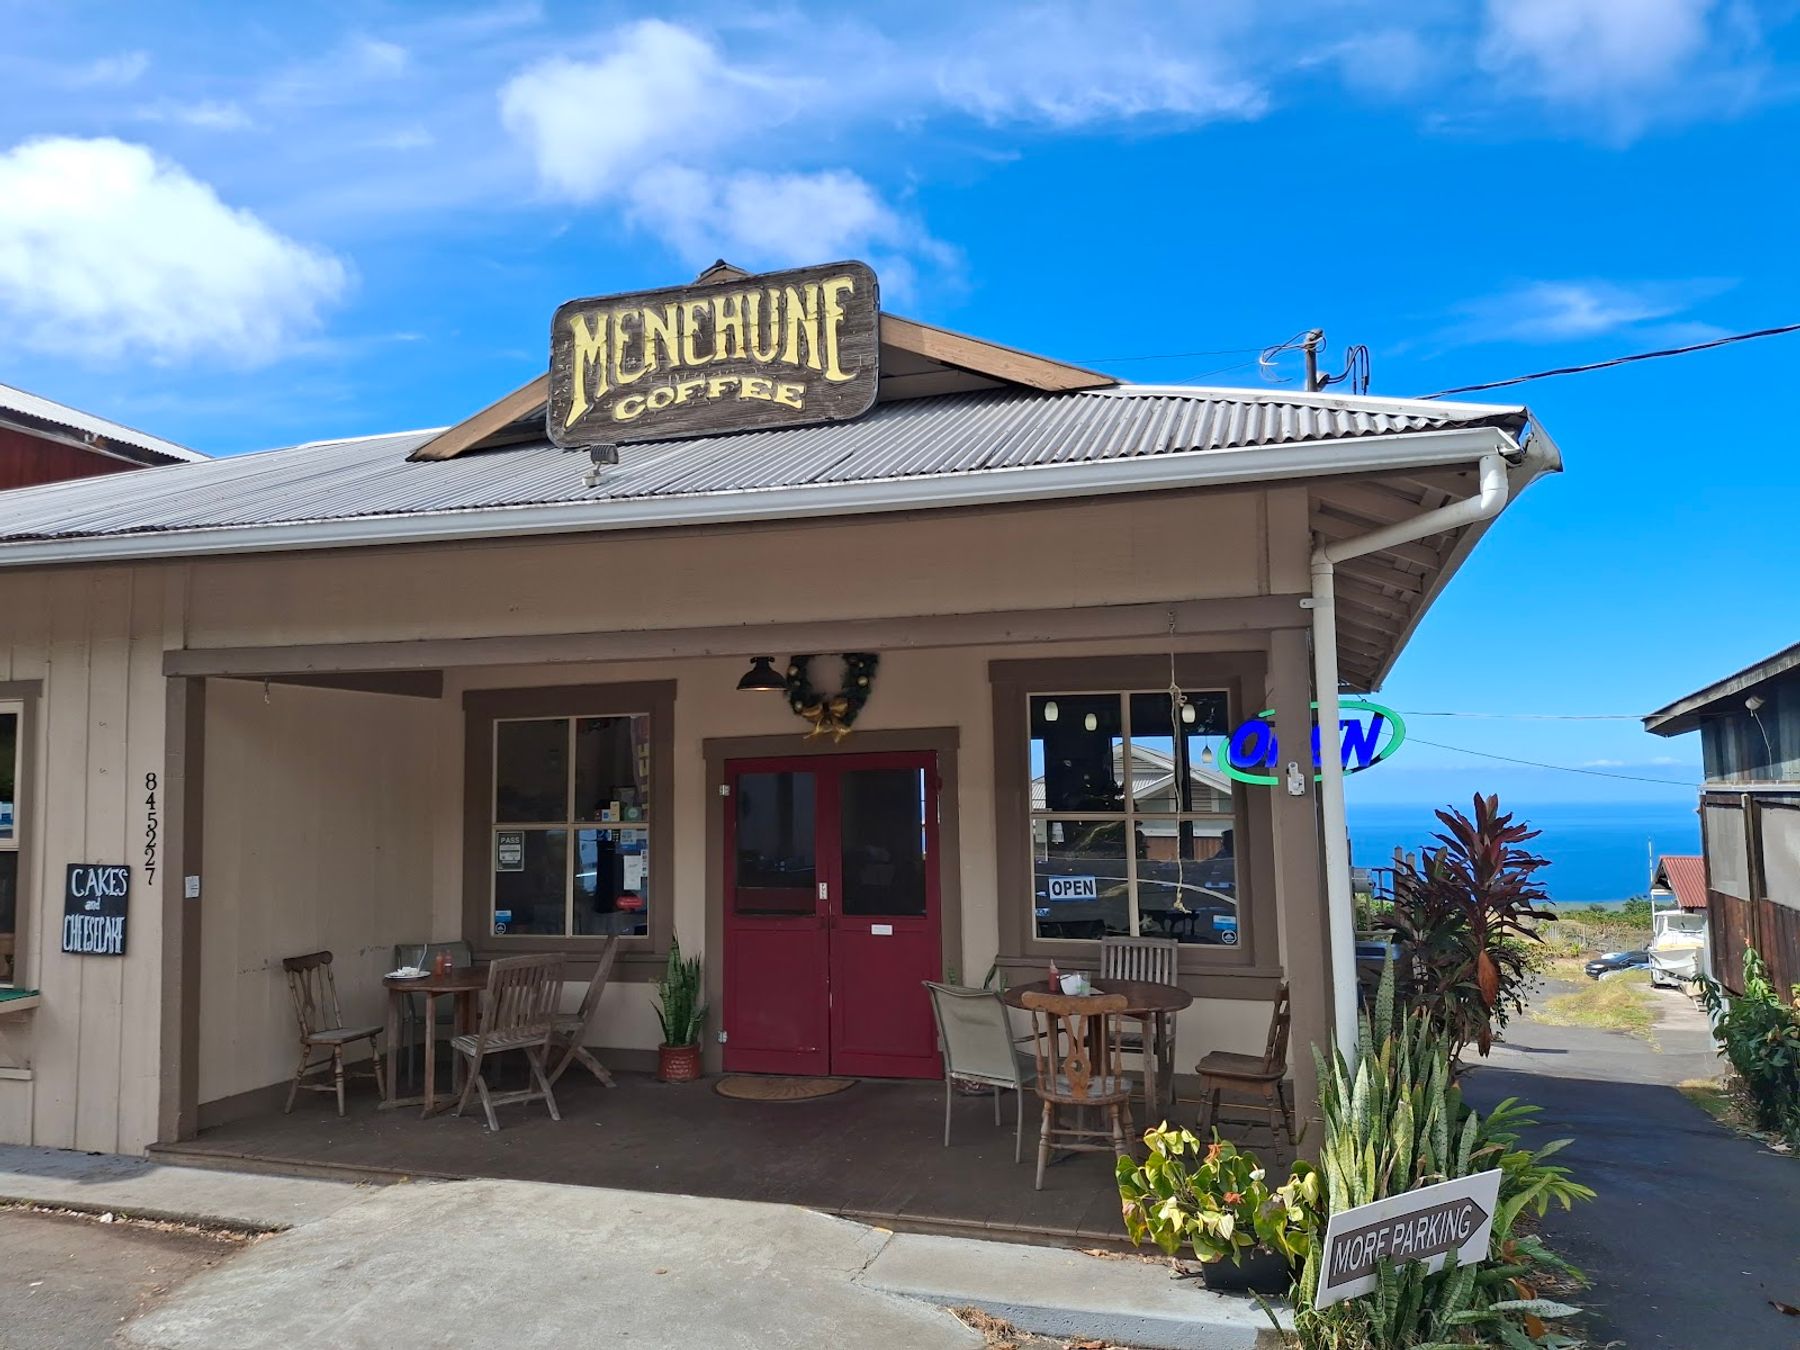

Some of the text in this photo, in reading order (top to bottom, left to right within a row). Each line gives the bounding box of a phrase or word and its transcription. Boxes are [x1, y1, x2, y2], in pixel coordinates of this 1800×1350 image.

[565, 276, 857, 428] MENEHUNE
[613, 376, 805, 420] COFFEE
[1230, 712, 1385, 769] ON
[145, 772, 157, 885] 845227
[500, 836, 520, 844] PASS
[72, 868, 128, 896] CAKES
[1051, 879, 1094, 896] OPEN
[84, 897, 101, 910] and
[64, 914, 125, 953] CHEESECAKE
[1333, 1205, 1472, 1276] MORE PARKING
